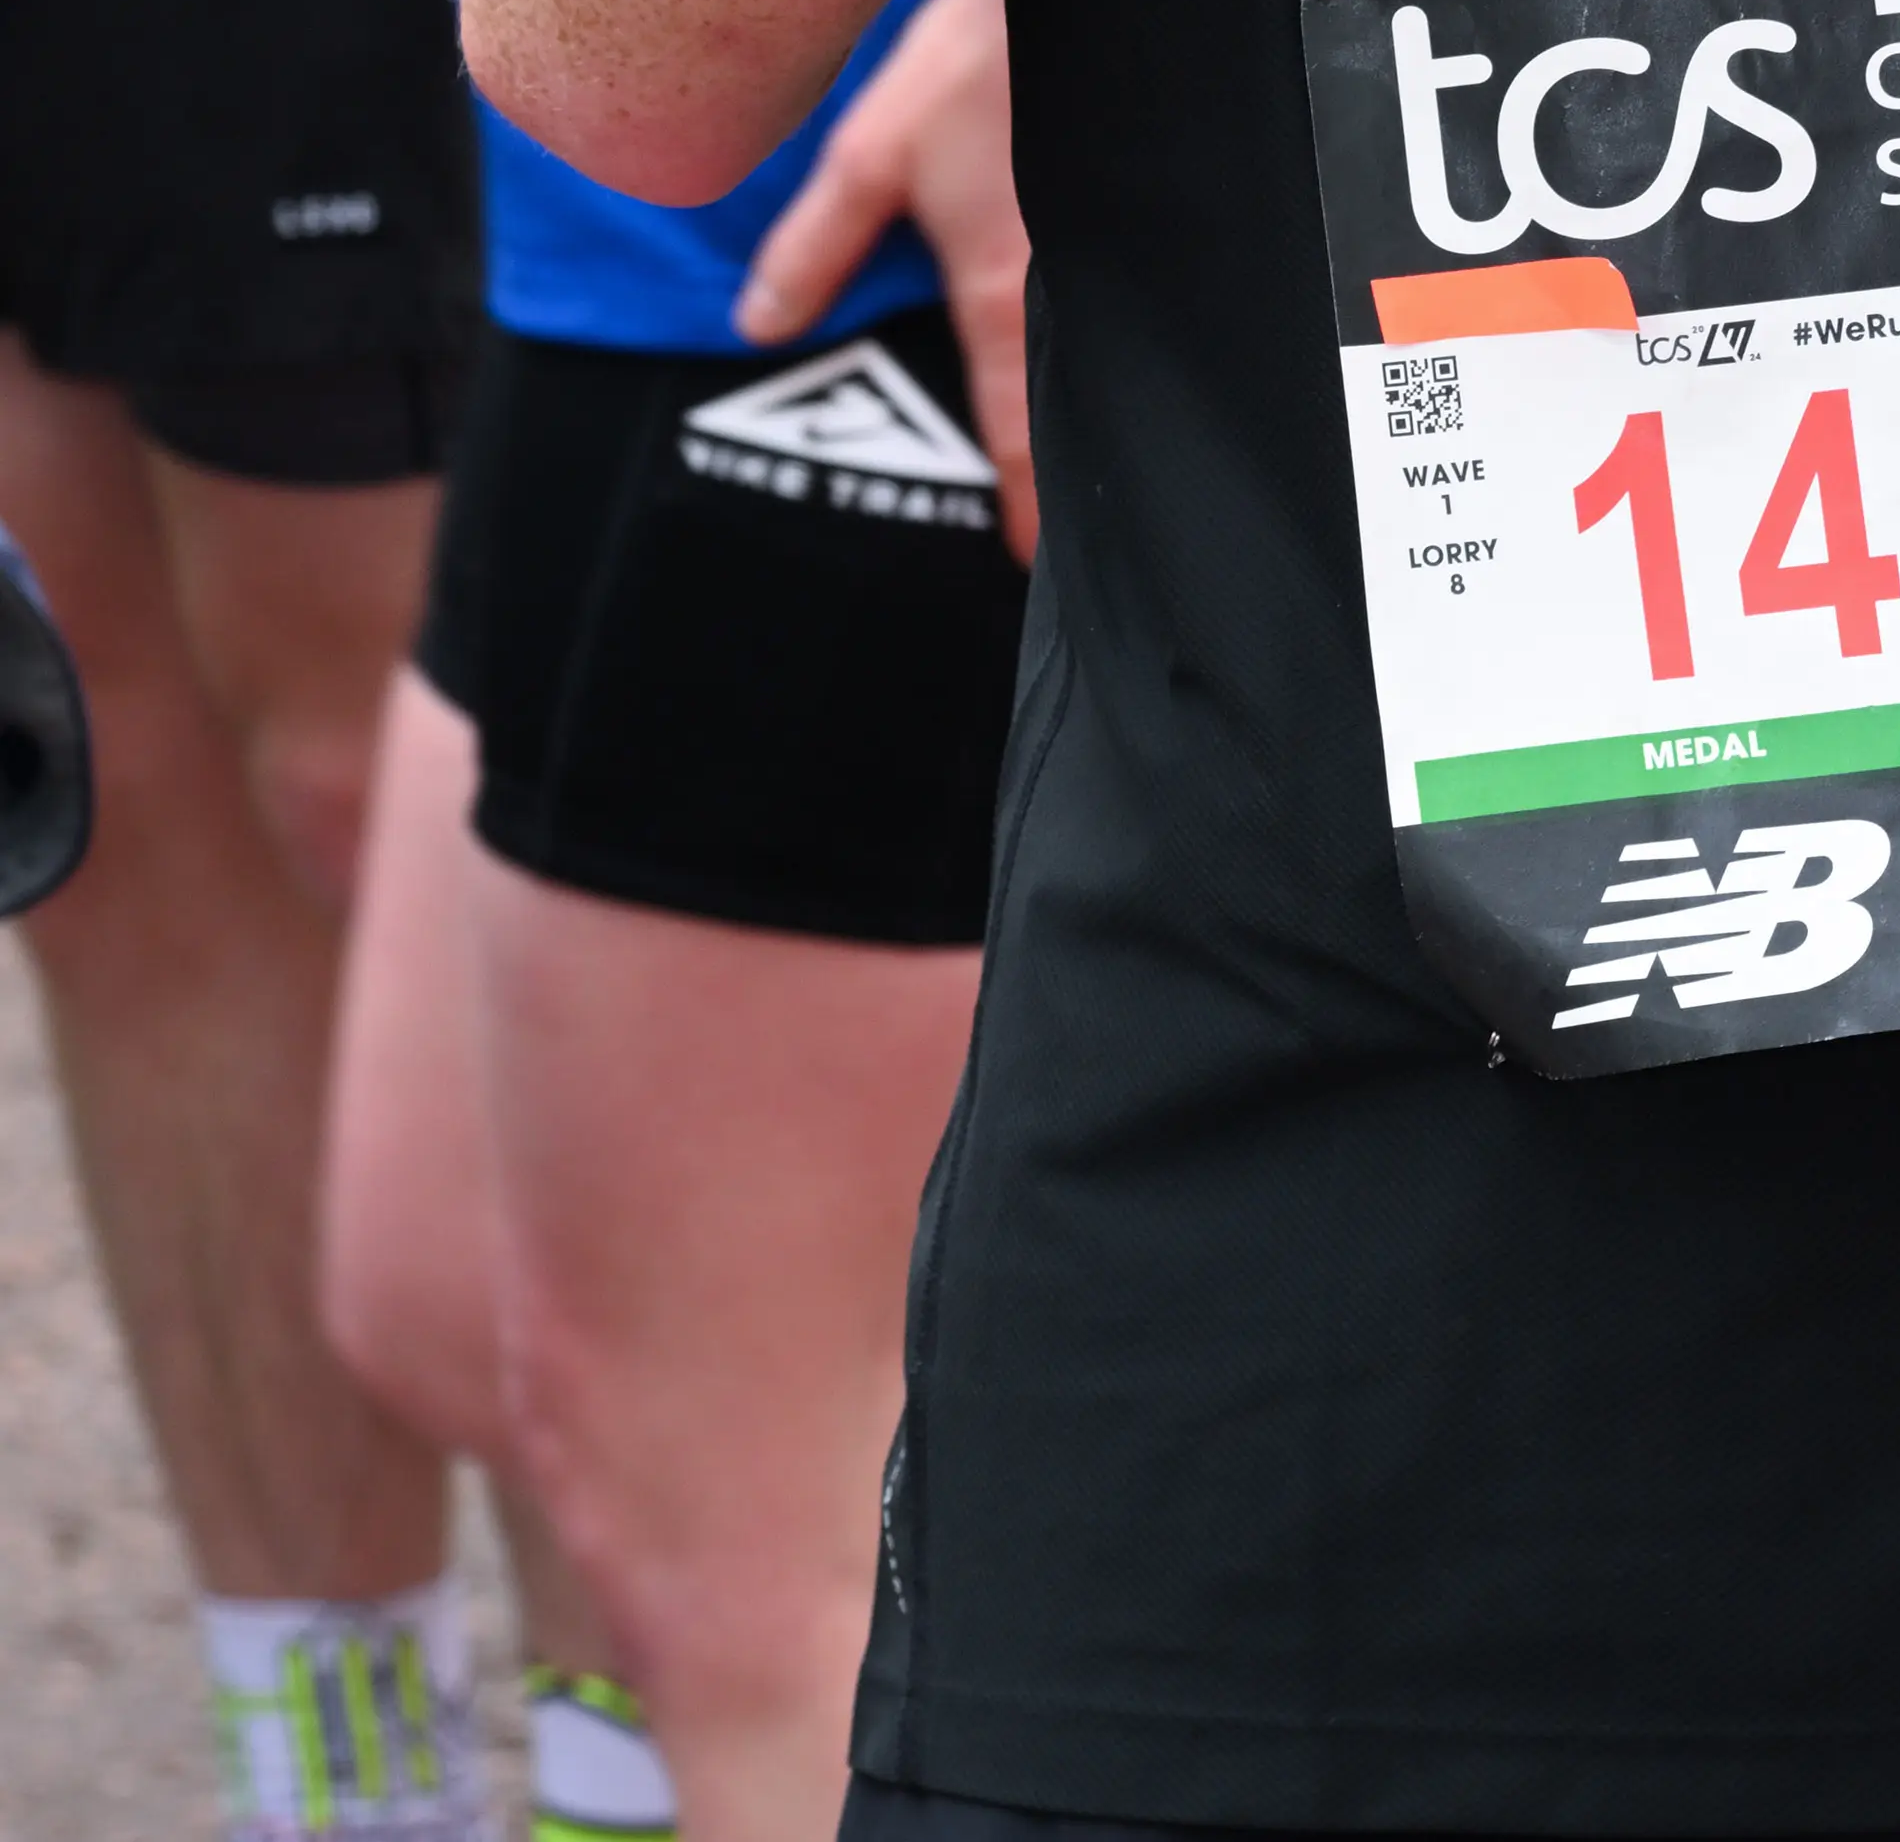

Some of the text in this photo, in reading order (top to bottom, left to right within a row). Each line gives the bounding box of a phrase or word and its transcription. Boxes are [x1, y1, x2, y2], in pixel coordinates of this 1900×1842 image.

[1391, 4, 1818, 255] tcs
[1635, 331, 1692, 366] tcs
[1402, 459, 1485, 488] WAVE
[1441, 494, 1452, 515] 1
[1409, 538, 1498, 568] LORRY
[1450, 573, 1466, 595] 8
[1641, 730, 1767, 771] MEDAL
